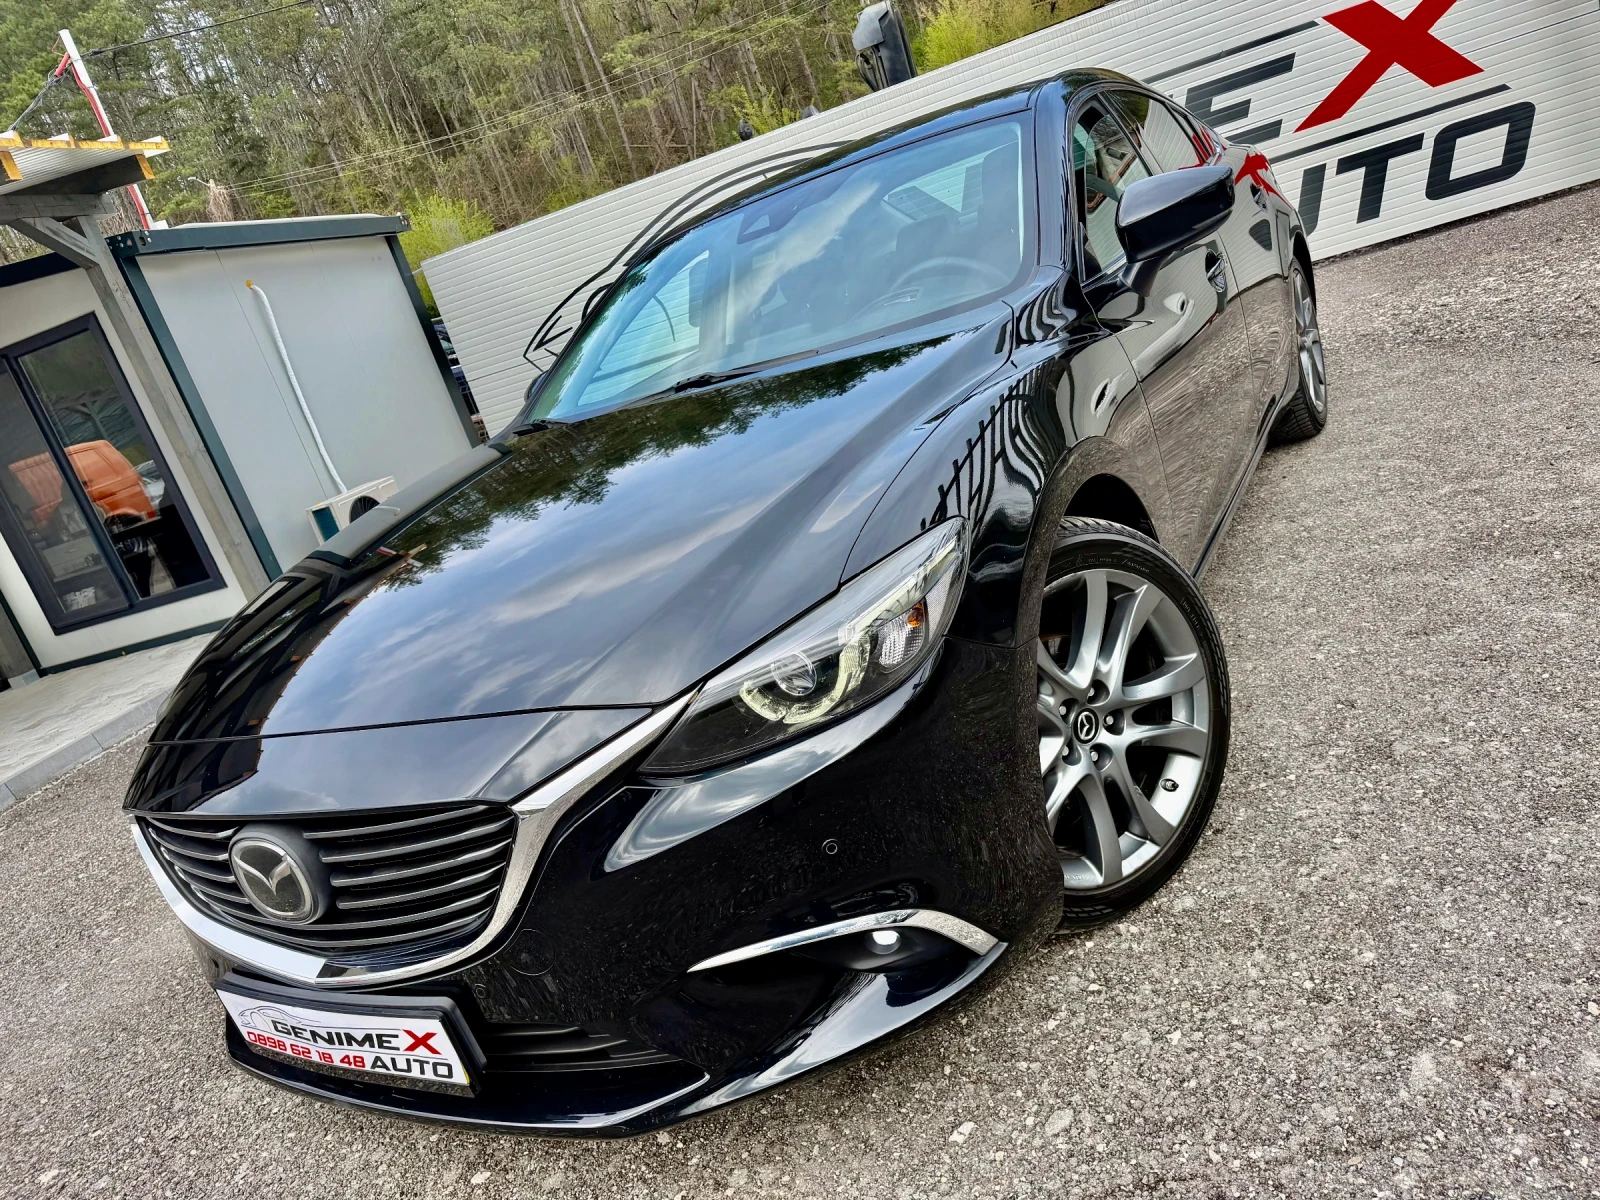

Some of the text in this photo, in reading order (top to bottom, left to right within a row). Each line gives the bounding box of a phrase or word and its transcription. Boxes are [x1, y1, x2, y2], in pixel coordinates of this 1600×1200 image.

[1169, 0, 1485, 145] EX
[246, 1031, 366, 1069] 0898 62 18 48
[271, 1020, 441, 1055] GENIMEX
[370, 1056, 453, 1079] AUTO
